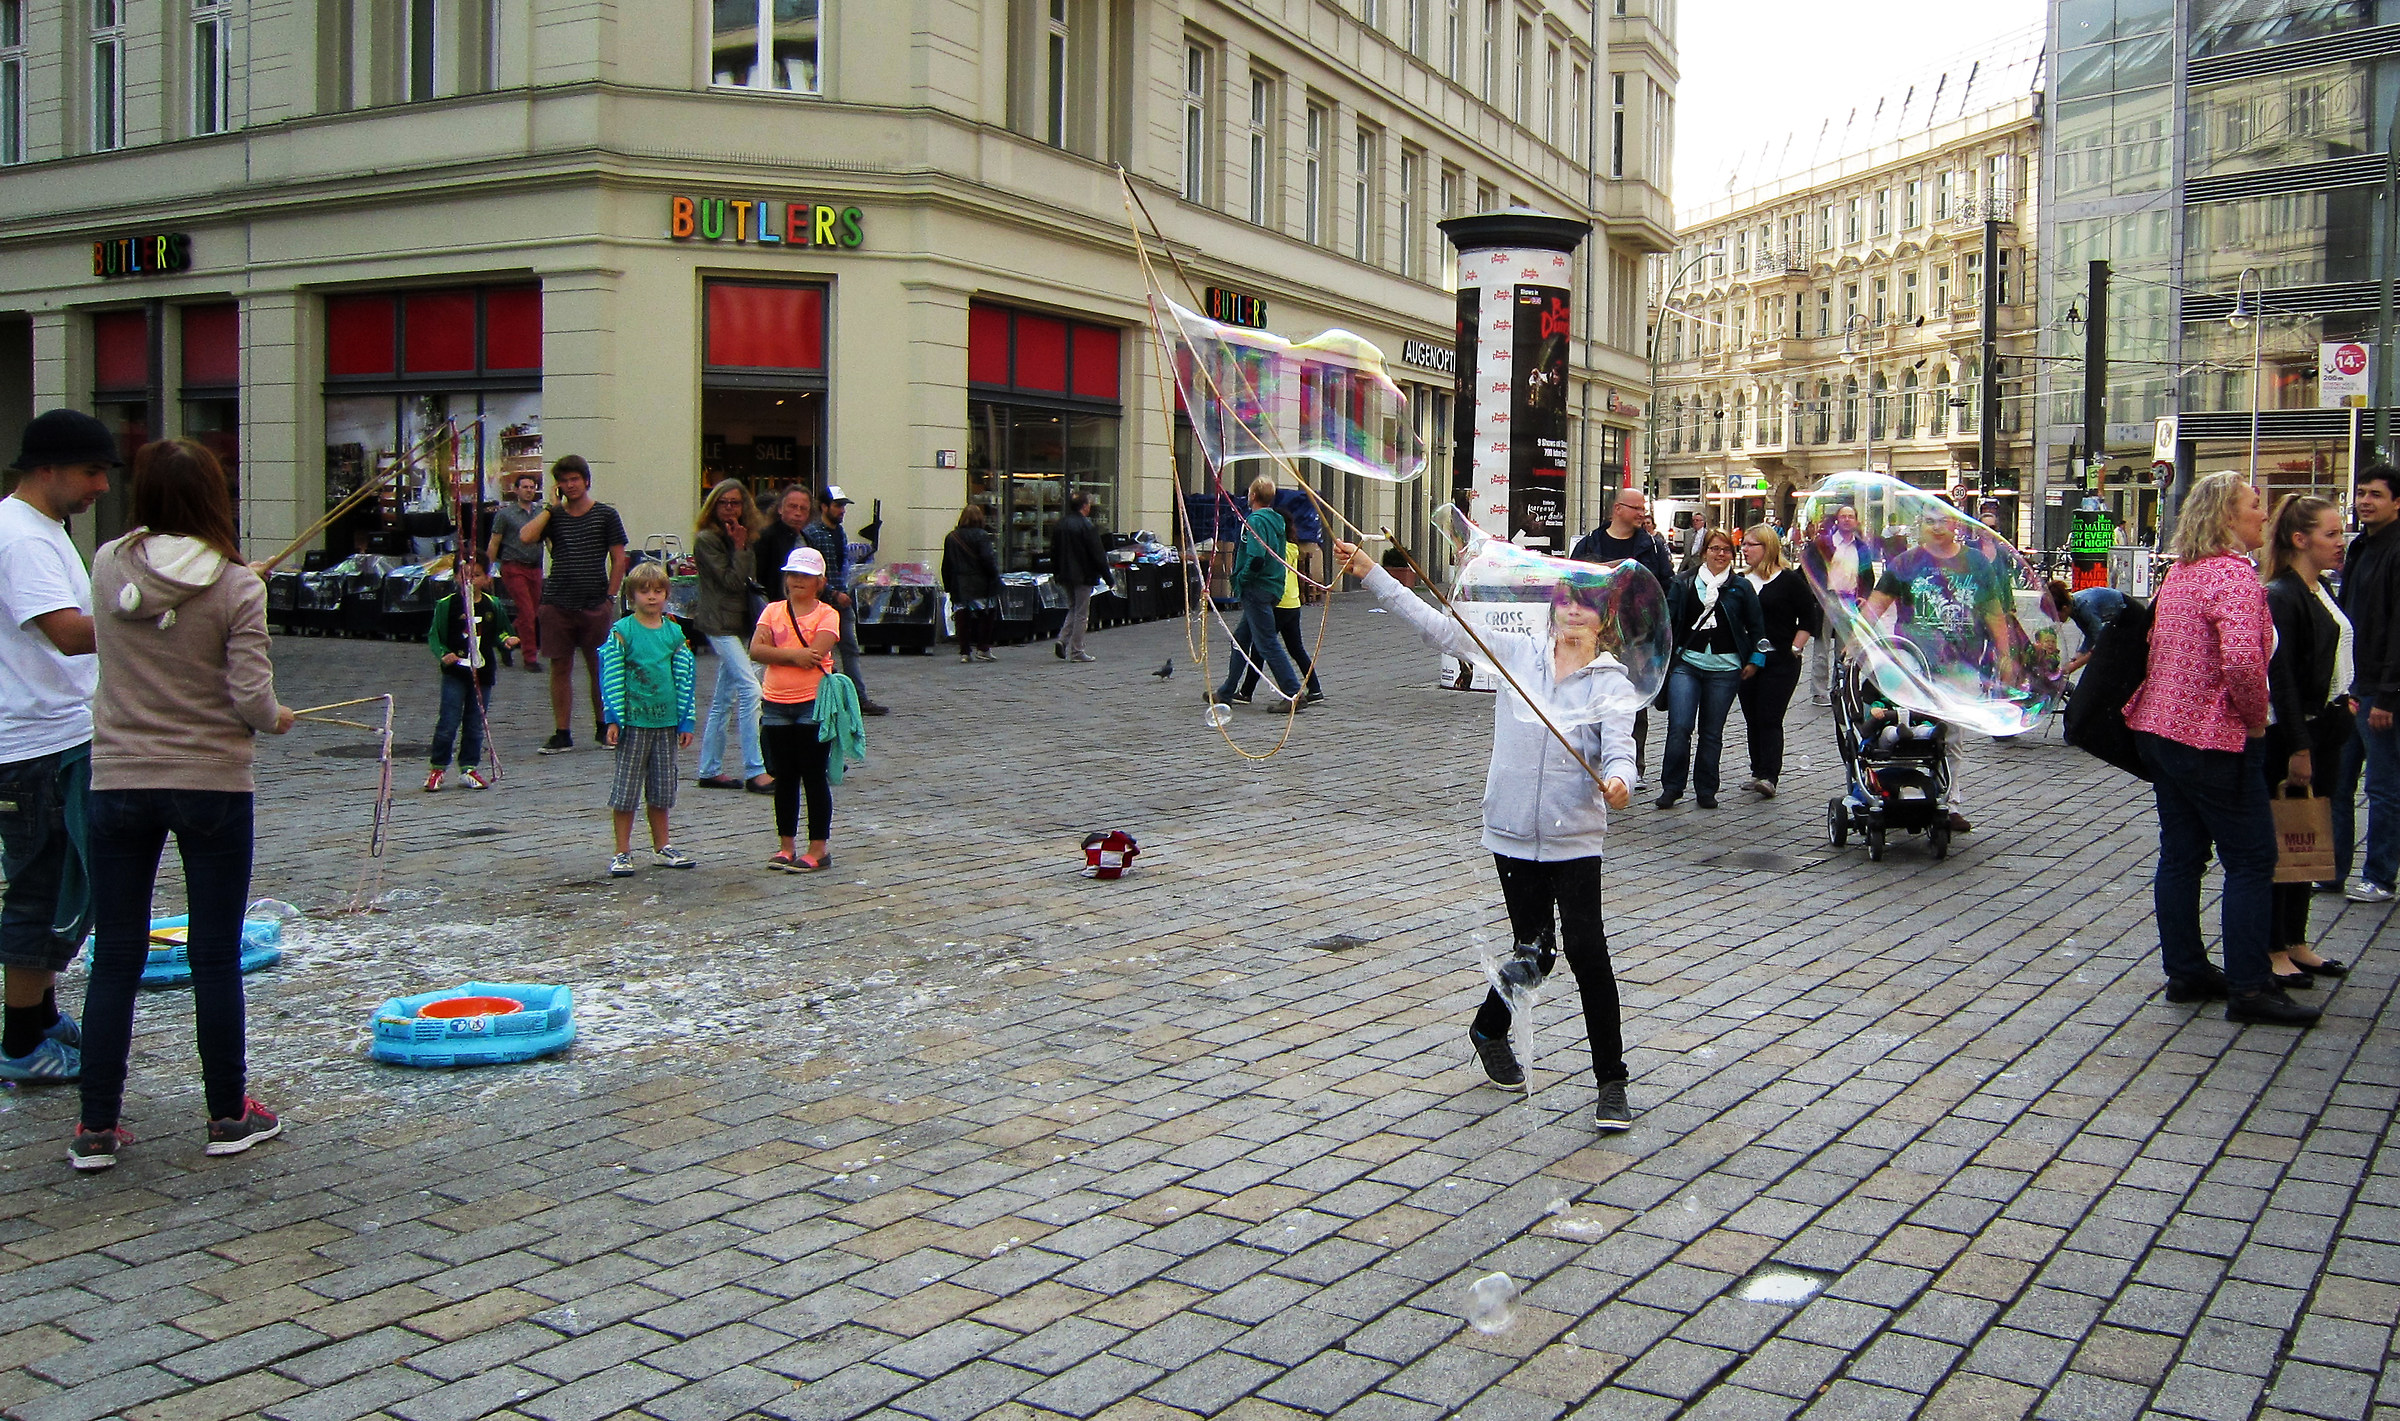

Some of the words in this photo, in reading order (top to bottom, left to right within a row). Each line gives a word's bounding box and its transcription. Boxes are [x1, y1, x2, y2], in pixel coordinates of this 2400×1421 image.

[672, 196, 864, 247] BUTLERS
[92, 231, 190, 276] BUTLERS
[1207, 287, 1268, 329] BUTLERS
[1404, 339, 1456, 373] AUGENOPTI
[756, 443, 793, 461] SALE
[1954, 487, 1965, 498] 30
[2084, 531, 2112, 539] EVERY
[2084, 539, 2112, 548] NIGHT
[1485, 611, 1524, 626] CROSS
[2284, 832, 2316, 846] MUJI
